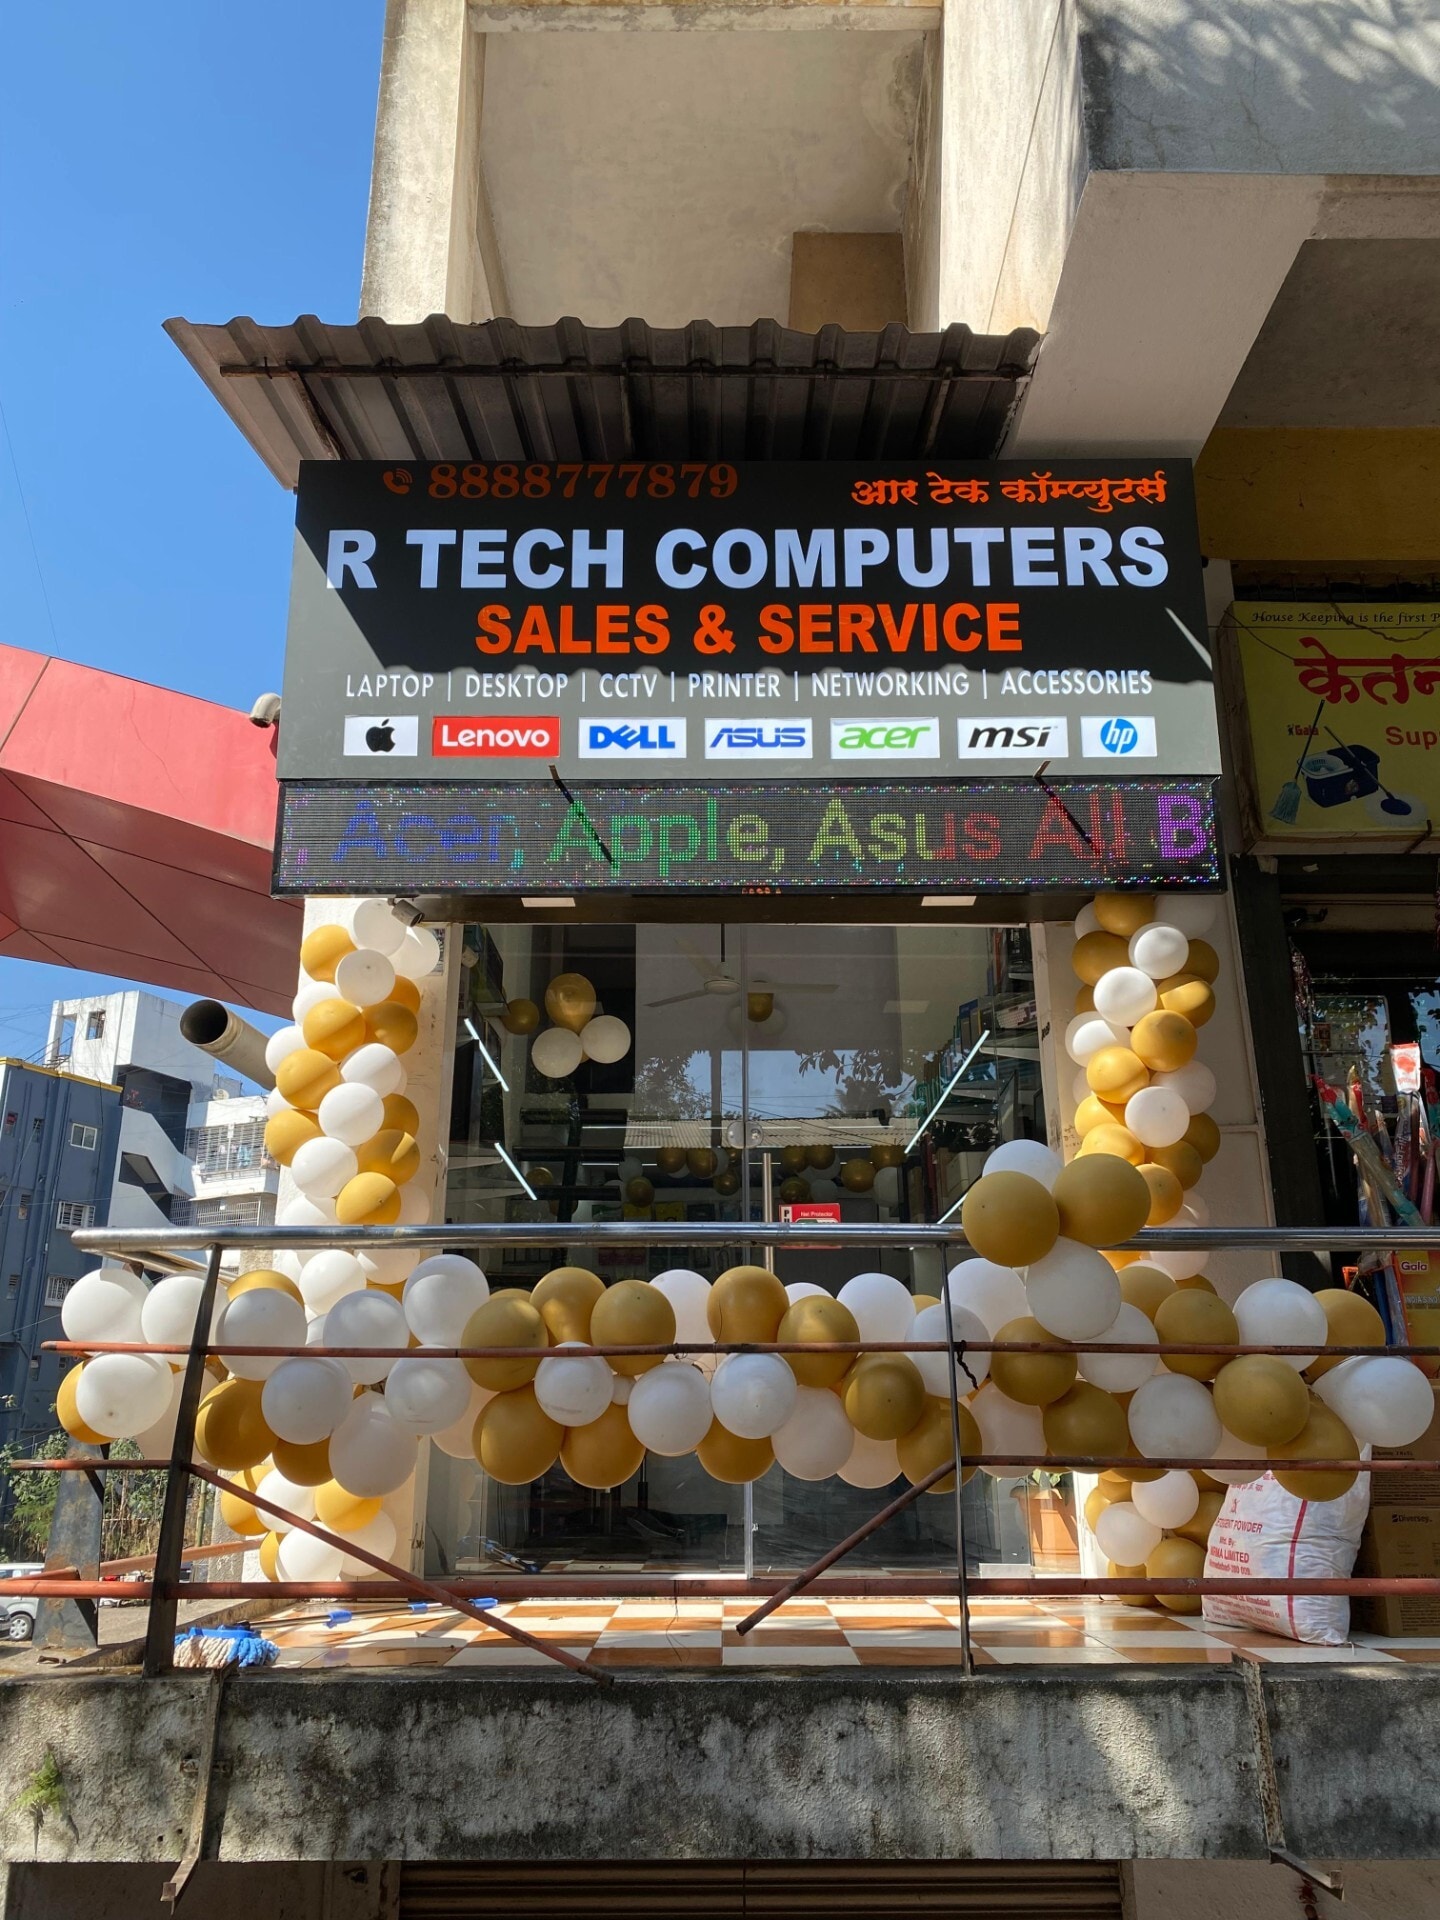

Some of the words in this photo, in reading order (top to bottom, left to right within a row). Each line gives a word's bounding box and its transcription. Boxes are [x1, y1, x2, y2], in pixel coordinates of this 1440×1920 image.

[428, 463, 738, 499] 8888777879
[851, 478, 919, 506] आर
[926, 471, 990, 506] टेक
[326, 529, 378, 589] R
[406, 528, 624, 589] TECH
[655, 526, 1169, 589] COMPUTERS
[475, 603, 672, 655] SALES
[692, 603, 737, 655] &
[758, 602, 1023, 655] SERVICE
[1252, 612, 1294, 623] House
[1298, 612, 1354, 626] Keeping
[1359, 612, 1368, 623] is
[1374, 612, 1394, 623] the
[1397, 612, 1426, 626] first
[346, 674, 434, 698] LAPTOP
[465, 674, 569, 698] DESKTOP
[599, 673, 658, 698] CCTV
[689, 673, 781, 697] PRINTER
[812, 672, 970, 696] NETWORKING
[1001, 670, 1153, 695] ACCESSORIES
[442, 724, 550, 748] Lenovo
[589, 725, 676, 749] DELL
[710, 727, 806, 748] ASUS
[838, 726, 931, 749] acer
[967, 727, 1051, 748] msi
[1103, 718, 1136, 754] hp
[544, 796, 785, 877] Apple,
[806, 796, 1002, 862] Asus
[1401, 1261, 1428, 1272] Gala
[1234, 1520, 1263, 1534] POWDER
[1224, 1549, 1250, 1564] LIMITED
